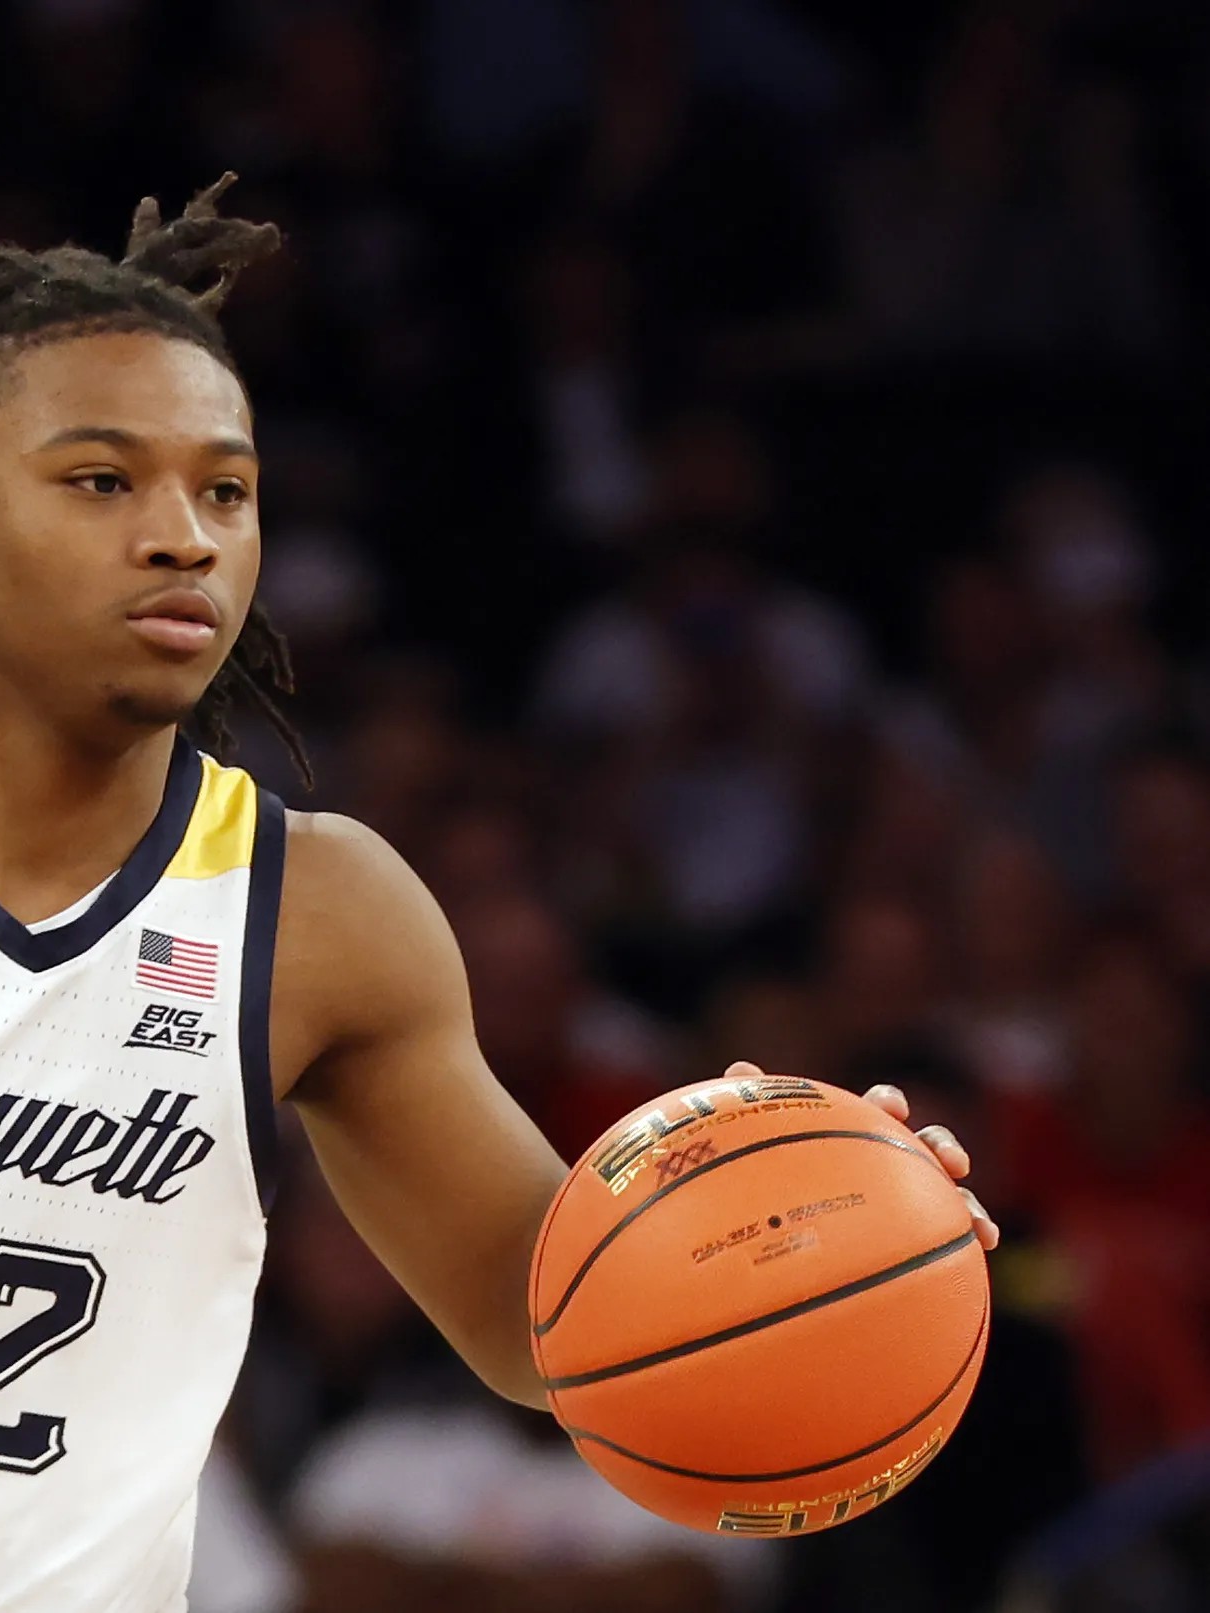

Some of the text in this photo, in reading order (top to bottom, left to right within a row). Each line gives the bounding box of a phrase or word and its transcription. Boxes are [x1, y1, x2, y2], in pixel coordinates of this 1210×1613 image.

[141, 1003, 204, 1028] BIG
[130, 1021, 218, 1049] EAST
[722, 1426, 943, 1512] CHAMPIONSHI
